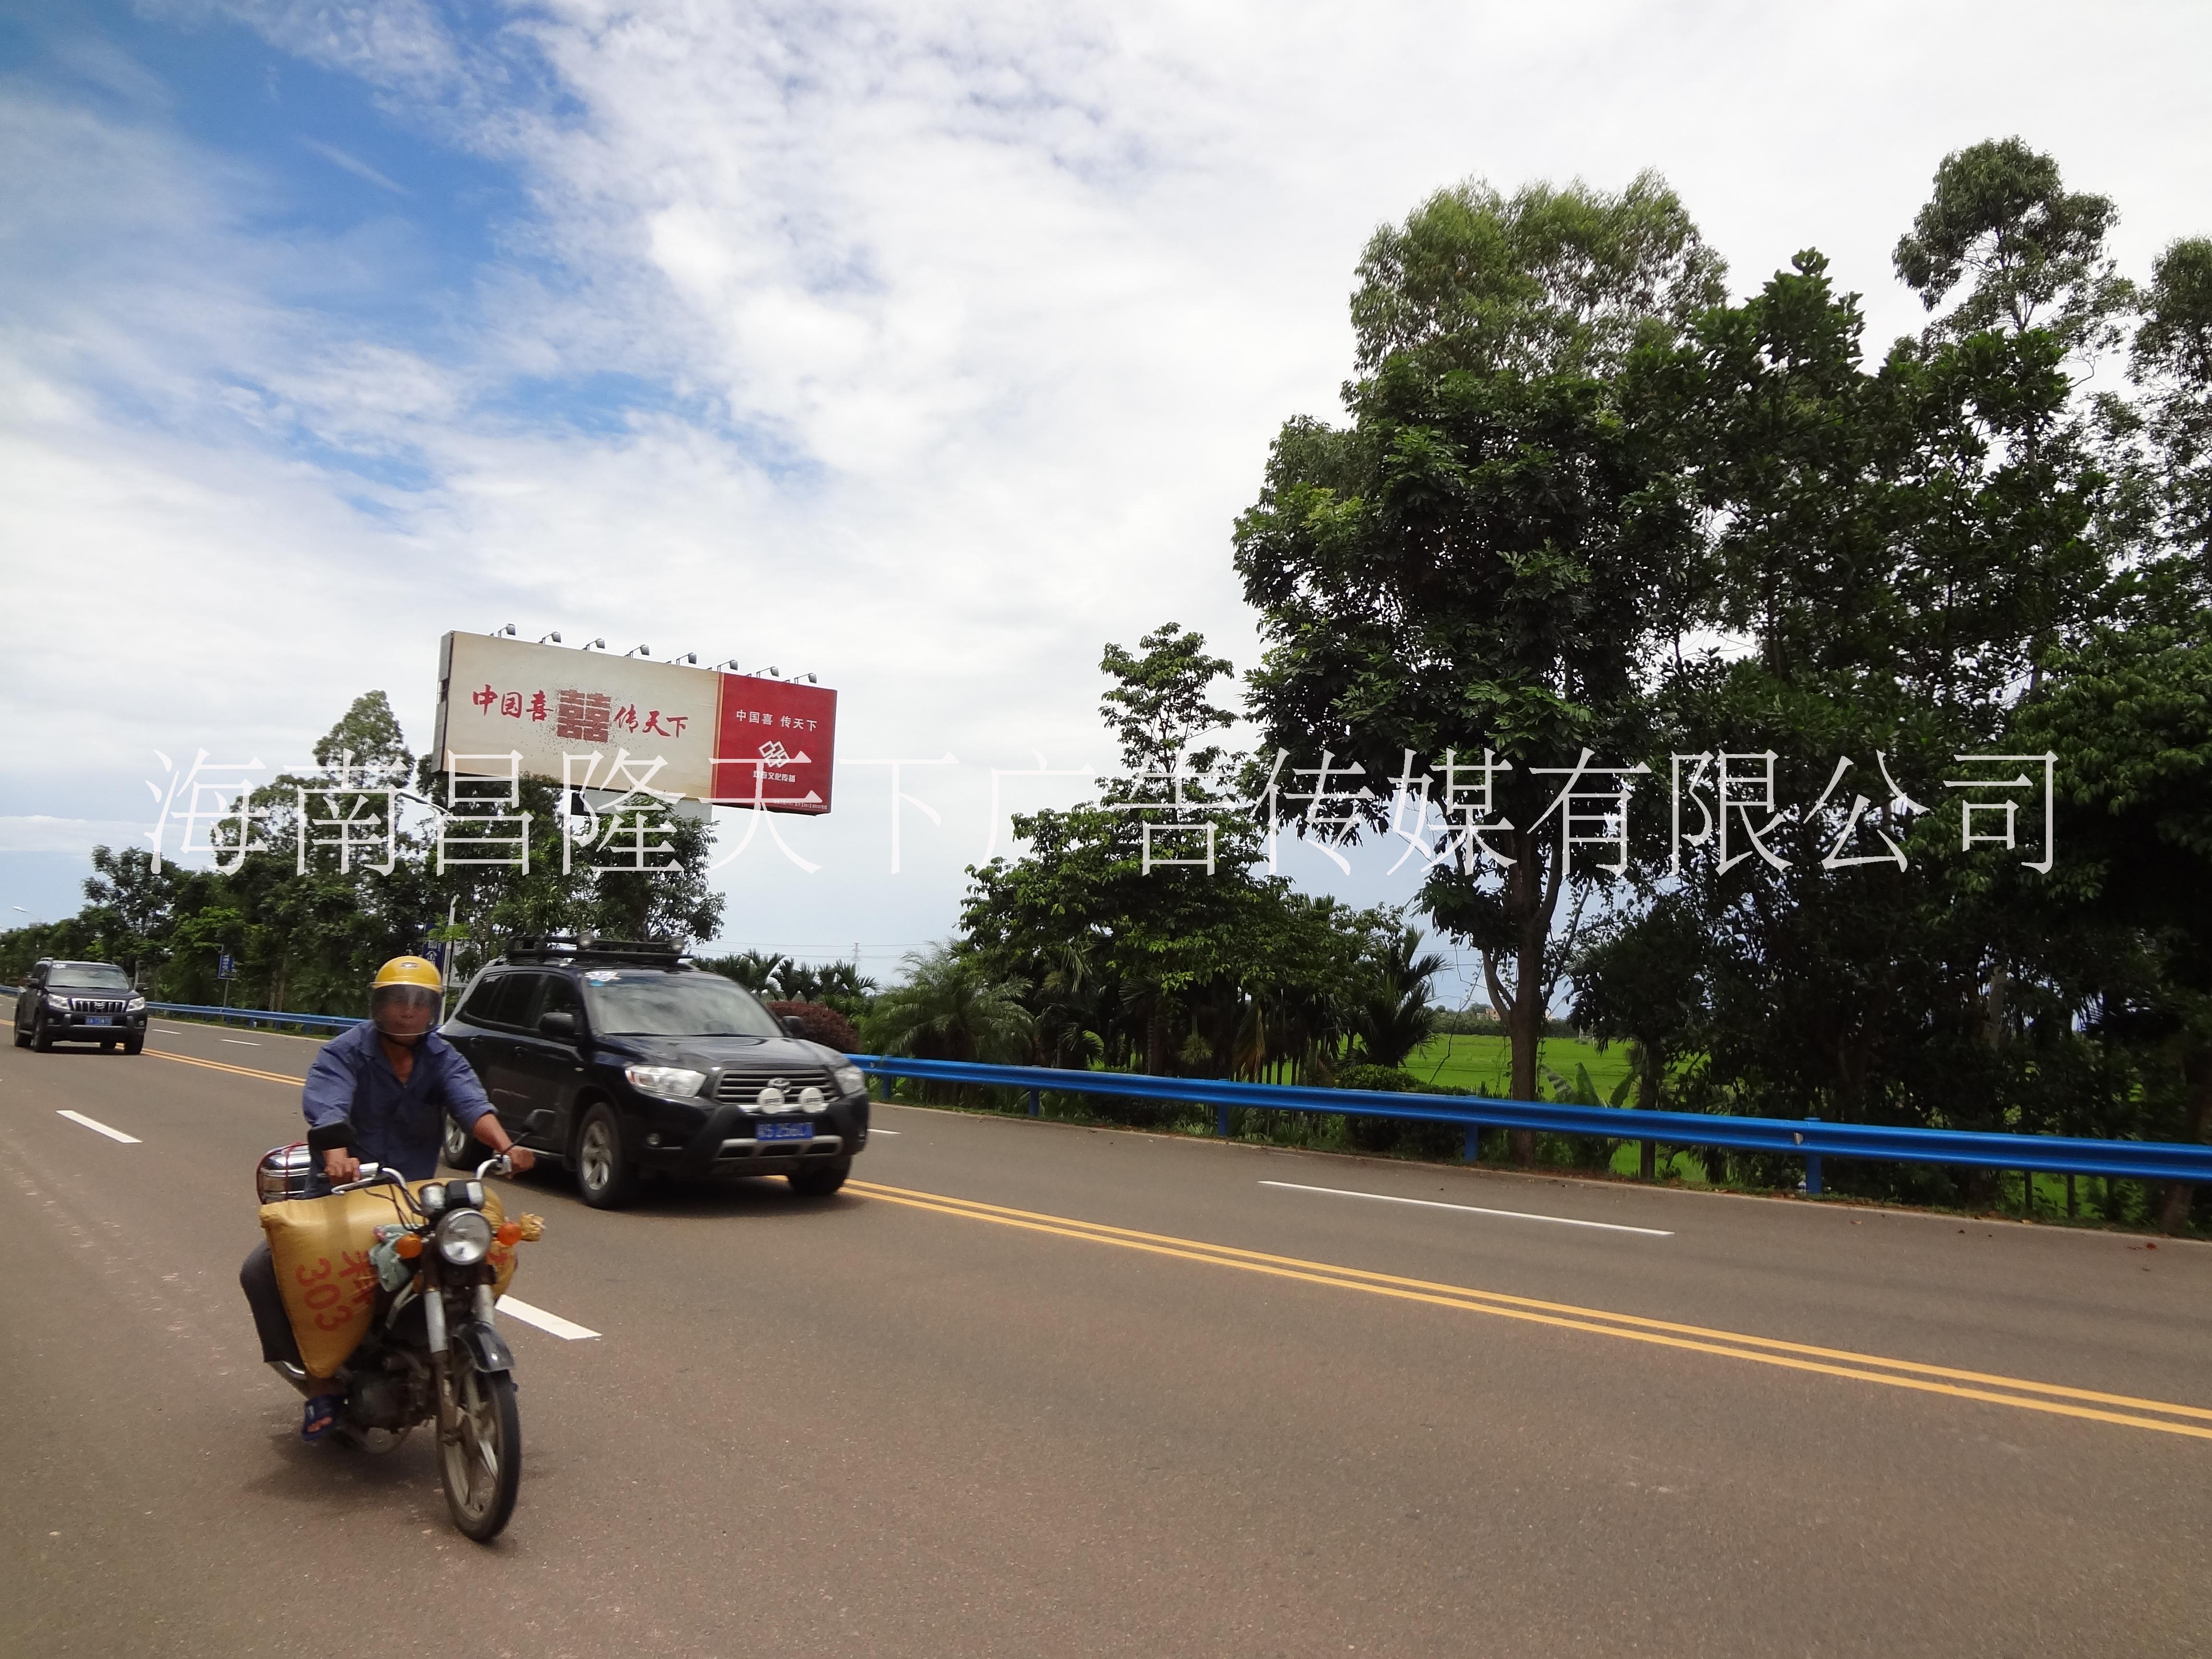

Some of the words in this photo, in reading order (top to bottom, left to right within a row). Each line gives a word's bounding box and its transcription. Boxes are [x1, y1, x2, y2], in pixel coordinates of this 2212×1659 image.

[473, 684, 553, 721] 中国喜
[613, 704, 689, 738] 传天下
[736, 709, 773, 725] 中国喜
[781, 715, 817, 732] 传天下
